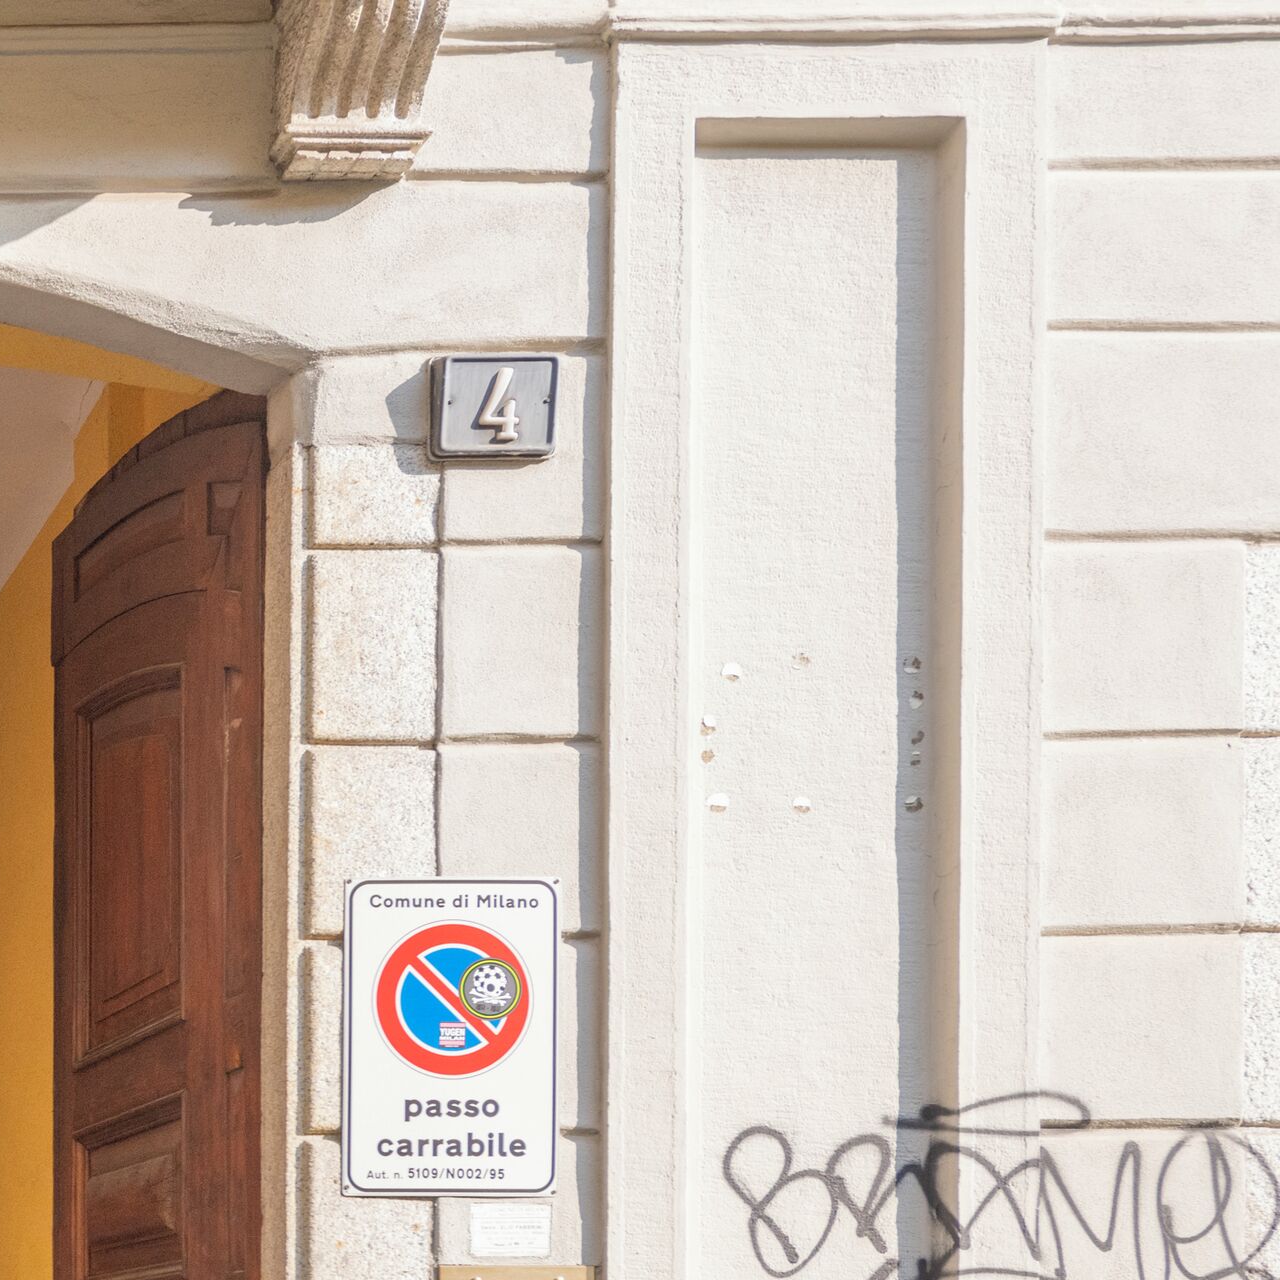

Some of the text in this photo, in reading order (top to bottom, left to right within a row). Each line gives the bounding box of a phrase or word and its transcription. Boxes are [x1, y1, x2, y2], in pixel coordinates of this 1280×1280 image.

[478, 366, 520, 441] 4
[369, 894, 540, 909] Comune di Milano
[403, 1098, 500, 1122] passo
[376, 1132, 527, 1157] carrabile
[366, 1167, 506, 1180] Aut. n. 5109/N002/95
